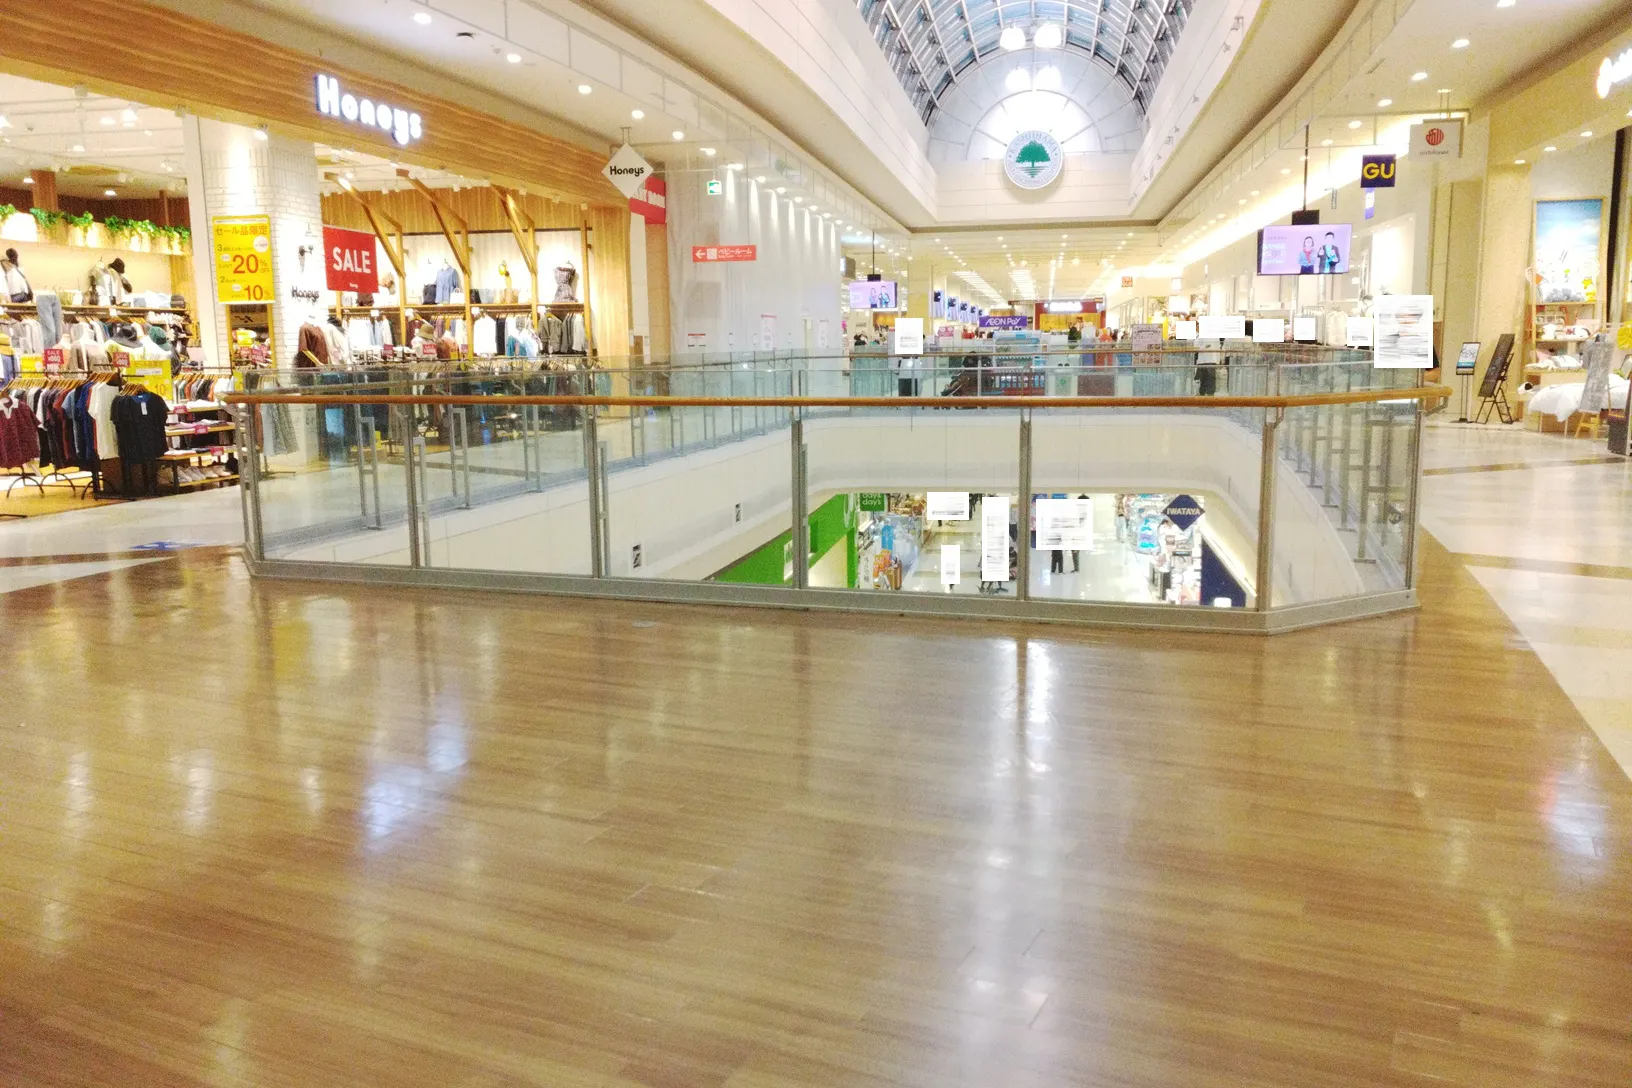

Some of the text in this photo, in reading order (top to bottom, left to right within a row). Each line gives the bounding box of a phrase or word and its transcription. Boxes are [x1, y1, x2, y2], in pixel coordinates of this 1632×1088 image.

[315, 73, 422, 145] Honeys
[609, 165, 645, 177] Honeys
[1362, 162, 1395, 180] GU
[332, 246, 371, 274] SALE
[291, 285, 320, 303] Honeys
[1166, 507, 1201, 515] IWATAYA
